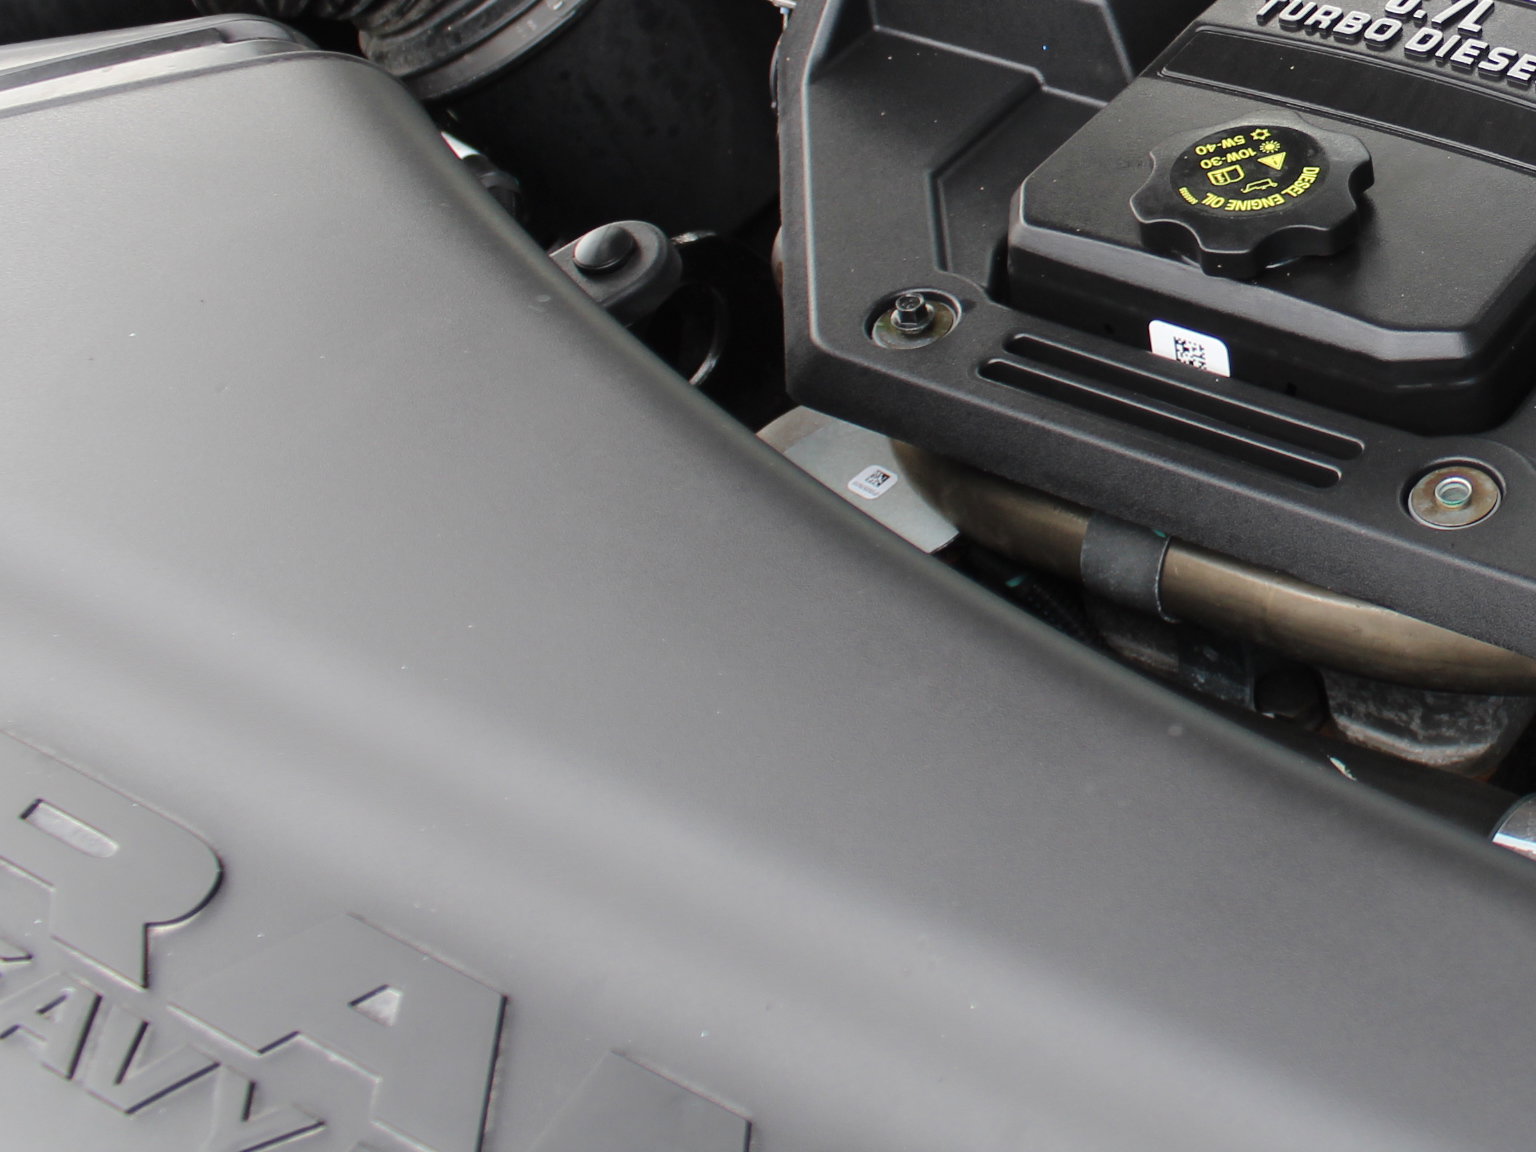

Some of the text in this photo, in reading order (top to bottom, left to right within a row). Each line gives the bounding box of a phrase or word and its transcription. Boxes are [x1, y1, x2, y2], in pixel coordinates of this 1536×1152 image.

[1195, 135, 1246, 156] 5W-40
[1201, 147, 1257, 170] 10W-30
[1282, 166, 1320, 197] DIESEL
[1201, 193, 1225, 210] OIL
[1225, 192, 1285, 211] ENGINE
